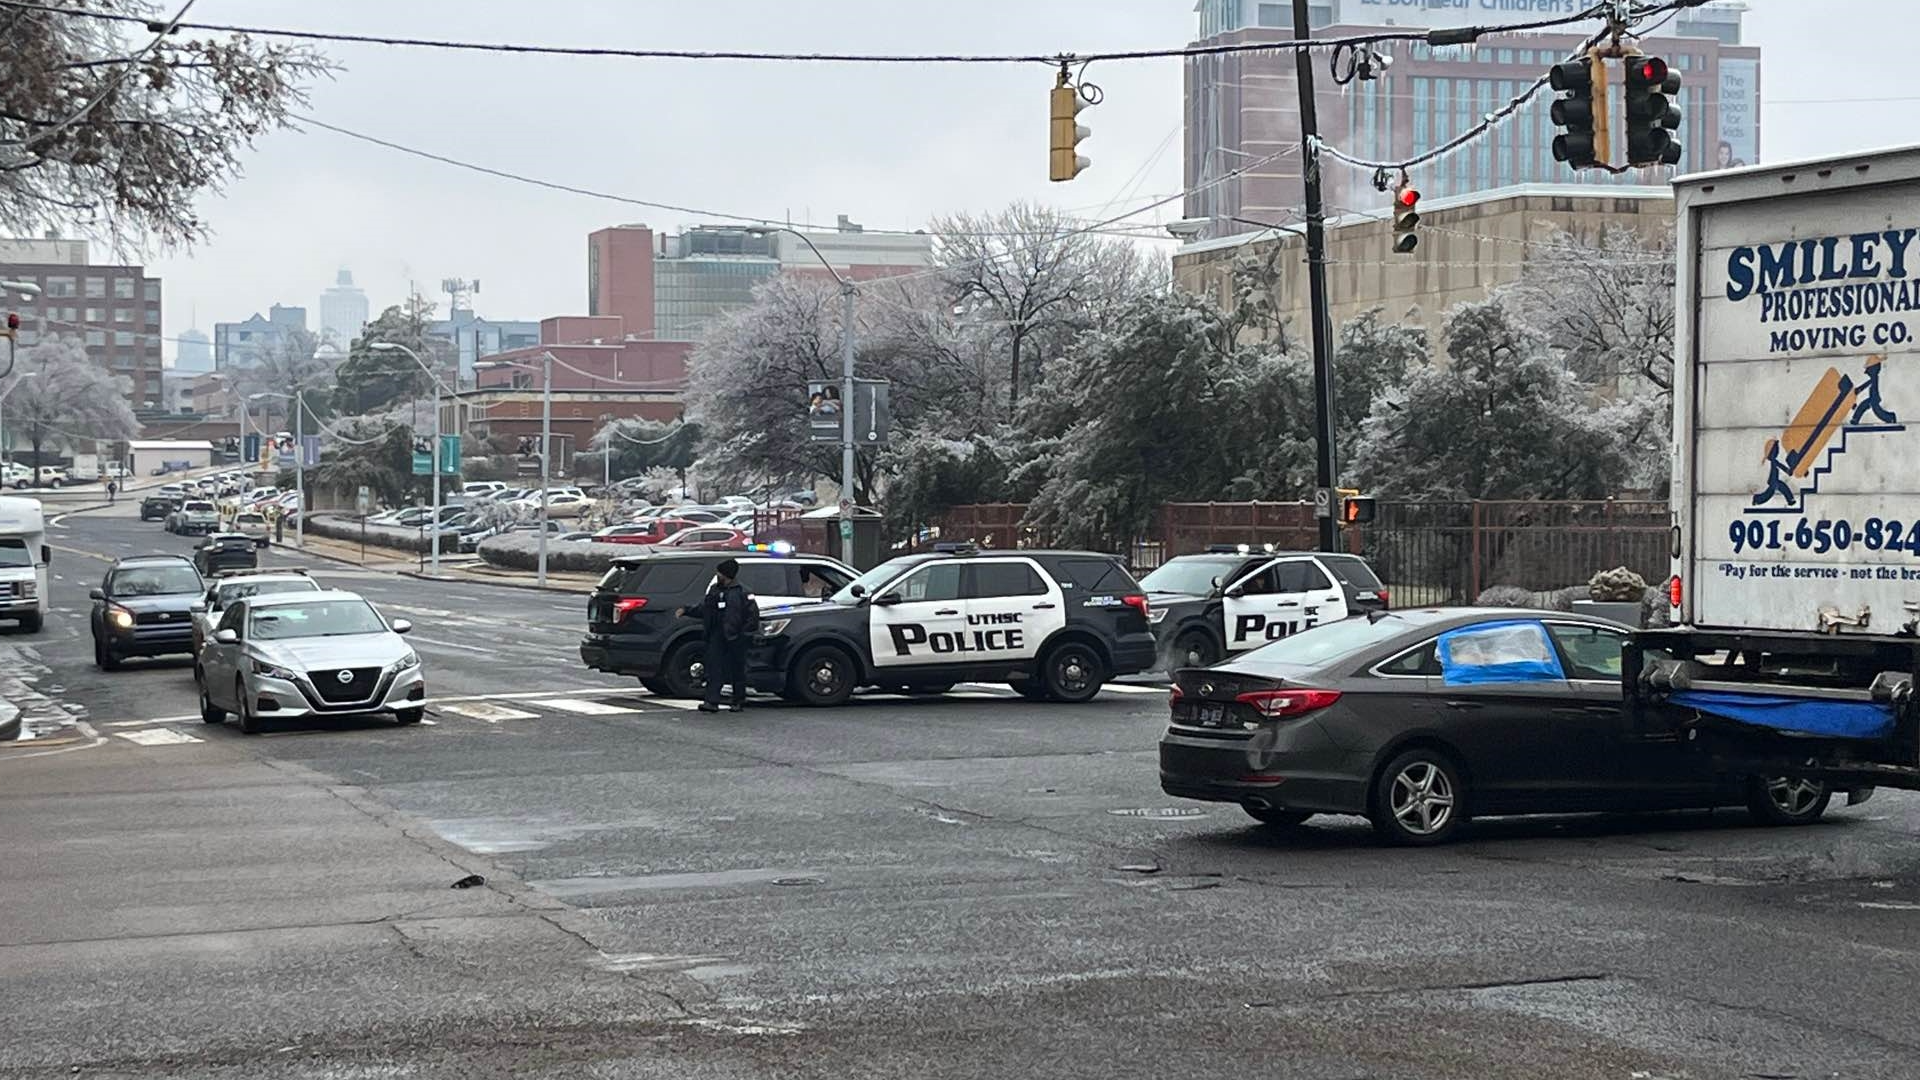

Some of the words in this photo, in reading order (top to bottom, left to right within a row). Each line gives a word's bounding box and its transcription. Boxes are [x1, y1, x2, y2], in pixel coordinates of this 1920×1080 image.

[1725, 75, 1744, 87] The
[1761, 279, 1920, 322] PROFESSIONAL
[1770, 325, 1866, 352] MOVING
[1873, 321, 1912, 345] CO.
[1749, 564, 1768, 577] for
[1771, 565, 1791, 577] the
[1794, 567, 1838, 578] service
[1850, 567, 1872, 579] not
[1876, 566, 1897, 579] the
[967, 612, 1023, 625] UTHSC
